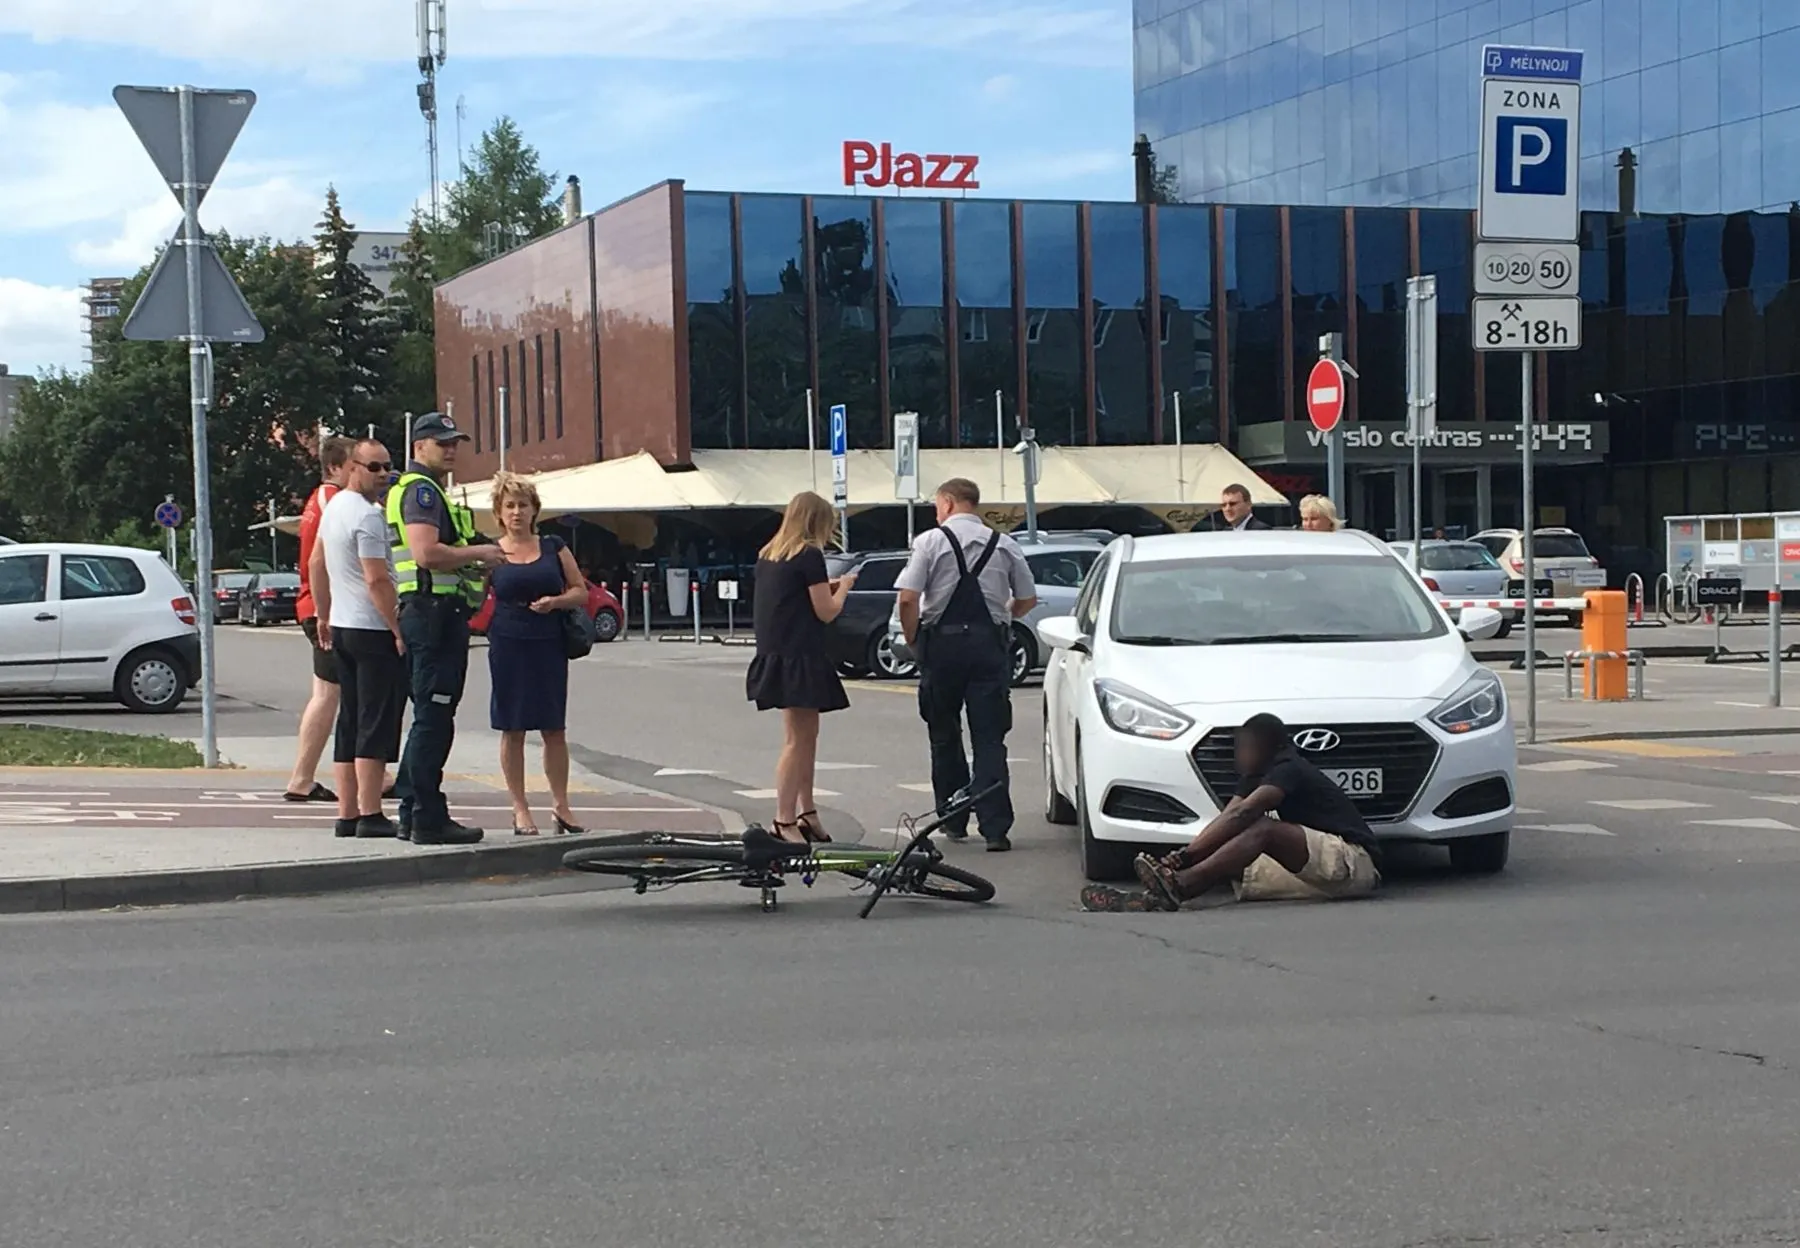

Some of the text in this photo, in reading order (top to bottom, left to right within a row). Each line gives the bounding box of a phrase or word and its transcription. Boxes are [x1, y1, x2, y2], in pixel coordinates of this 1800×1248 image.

[1510, 53, 1569, 72] MĖLYNOJI
[1503, 90, 1561, 110] ZONA
[843, 141, 980, 189] PJazz
[1511, 125, 1552, 187] P
[1487, 261, 1565, 279] 10 20 50
[1485, 320, 1568, 345] 8-18h
[834, 412, 843, 451] P
[1306, 425, 1383, 447] vslo
[1509, 588, 1542, 596] ORCLE
[1699, 586, 1739, 596] ORACLE
[1337, 770, 1379, 791] 266
